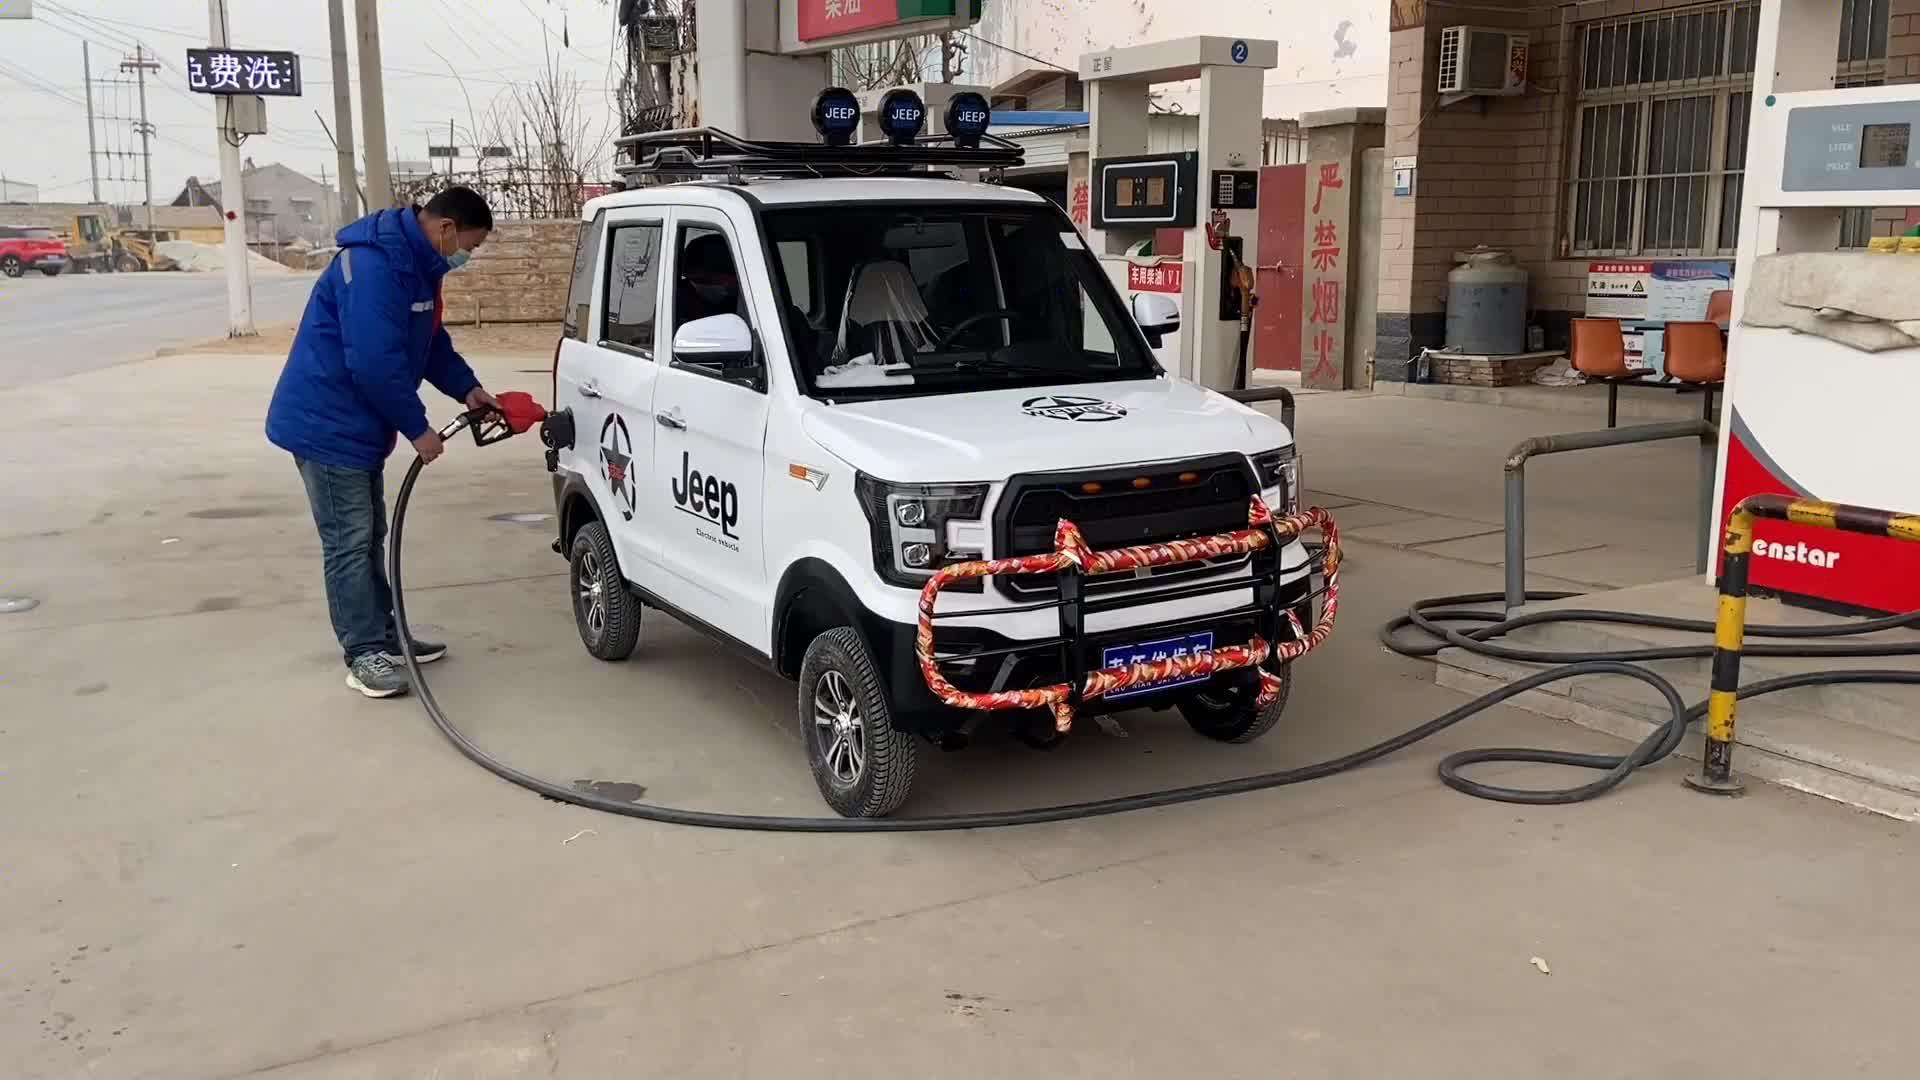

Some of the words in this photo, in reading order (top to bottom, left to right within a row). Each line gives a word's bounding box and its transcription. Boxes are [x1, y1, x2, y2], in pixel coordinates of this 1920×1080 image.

[1236, 44, 1245, 60] 2
[189, 53, 292, 90] 免费洗
[825, 107, 855, 120] JEEP
[891, 108, 921, 121] JEEP
[958, 110, 986, 123] JEEP
[1310, 162, 1343, 382] 严禁烟火
[672, 450, 738, 535] Jeep
